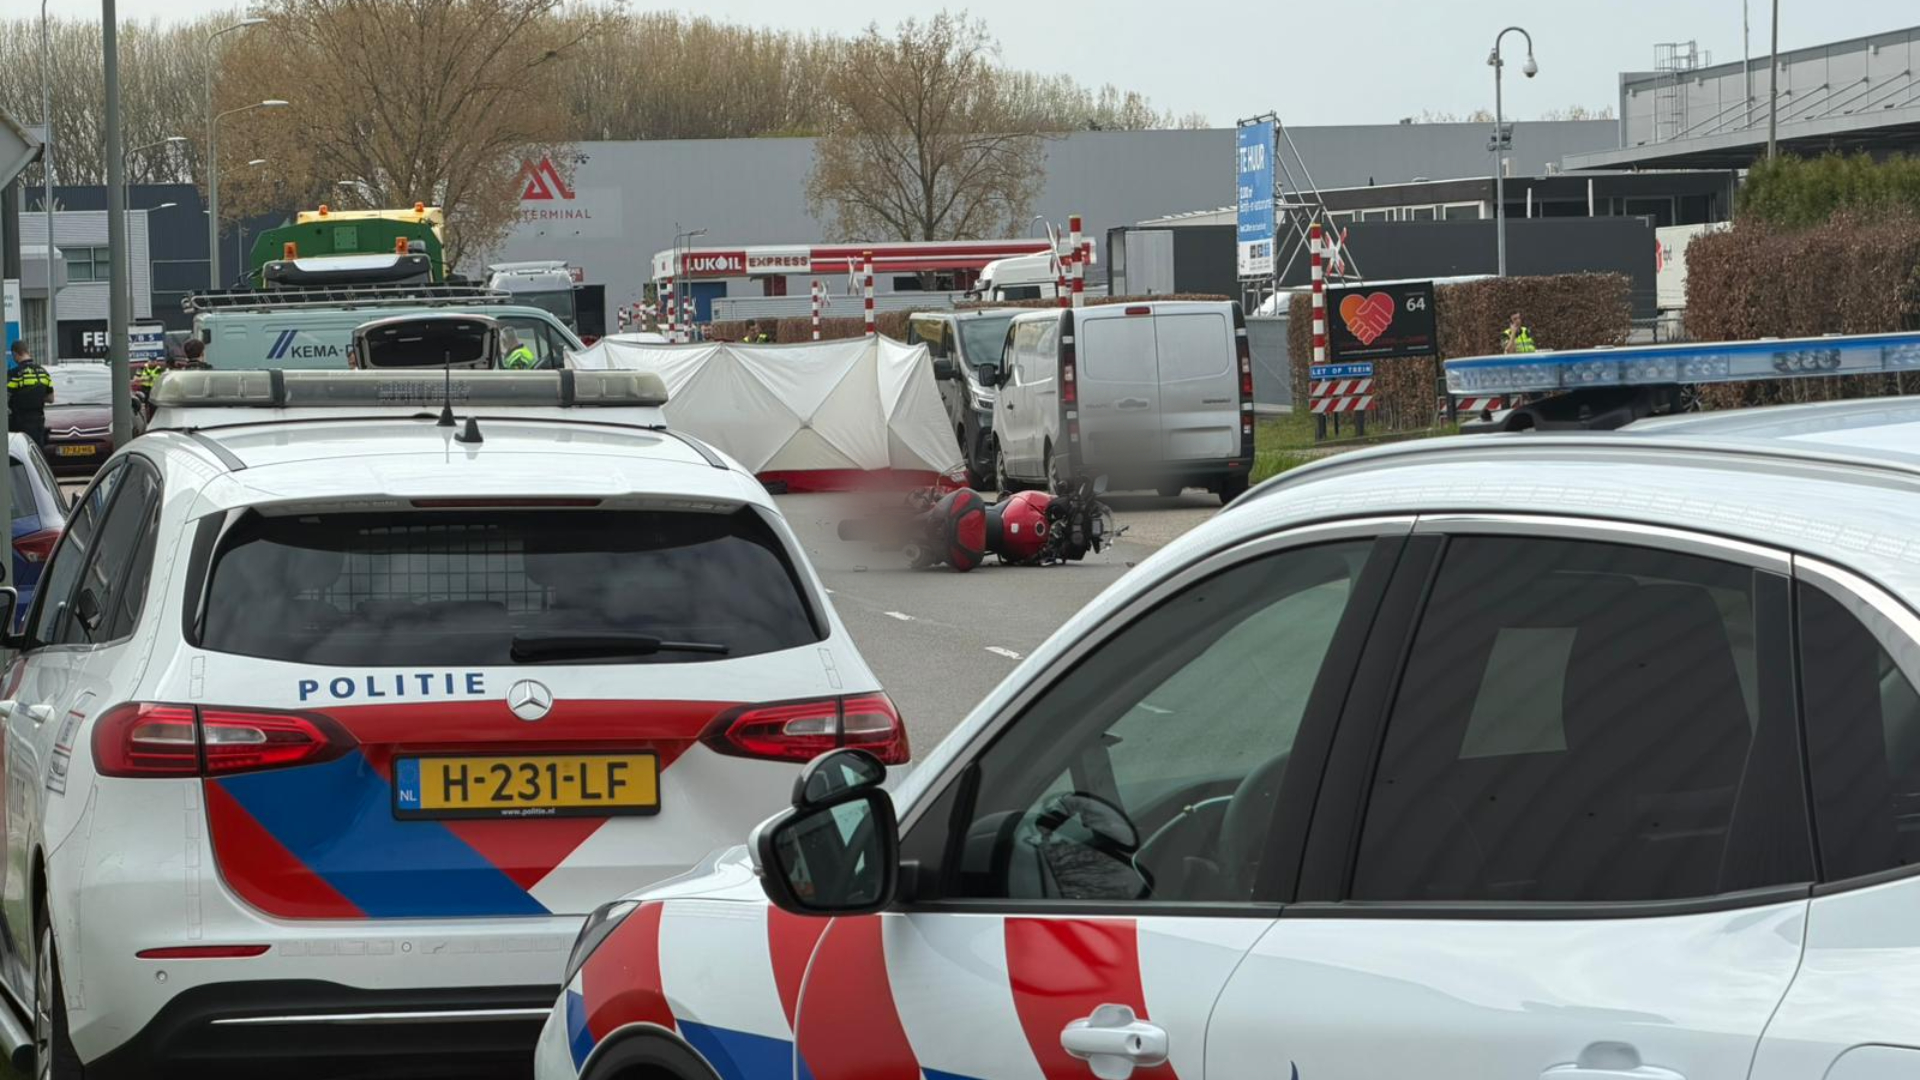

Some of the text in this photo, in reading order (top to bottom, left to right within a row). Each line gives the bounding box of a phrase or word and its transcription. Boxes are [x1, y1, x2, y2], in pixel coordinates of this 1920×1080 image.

[686, 256, 808, 272] LUKOIL EXPRESS
[1405, 297, 1426, 312] 64
[1312, 365, 1371, 376] LET OP TREIN
[299, 672, 486, 701] POLITIE
[400, 761, 629, 802] NL H-231-LF
[501, 807, 555, 816] www.politie.nl
